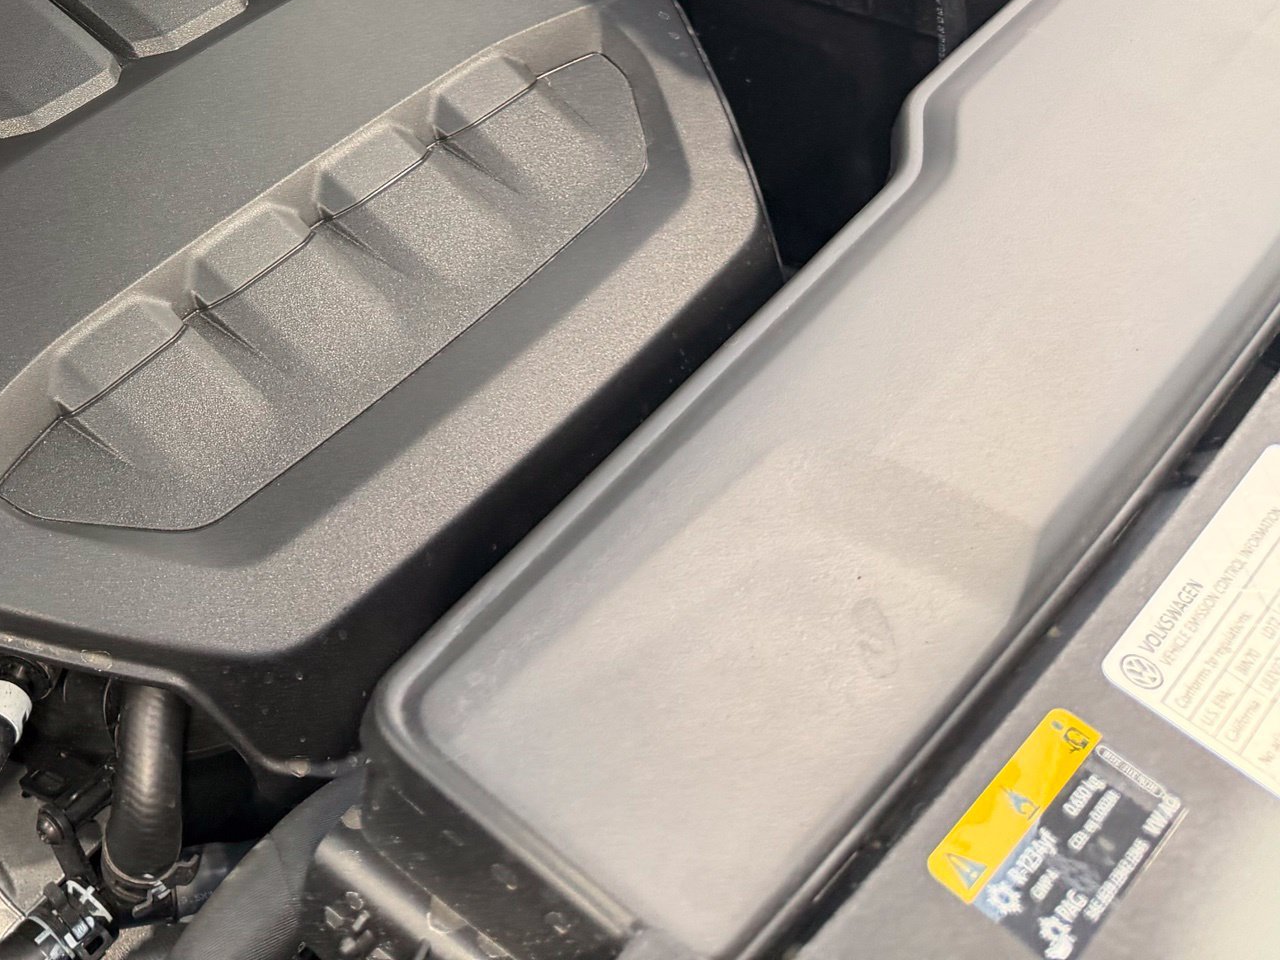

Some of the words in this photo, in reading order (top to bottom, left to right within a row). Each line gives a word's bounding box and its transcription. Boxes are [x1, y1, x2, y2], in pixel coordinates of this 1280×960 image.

[1138, 578, 1204, 653] VOLKSWAGEN
[1160, 629, 1191, 666] VEHICLE
[1184, 593, 1220, 633] EMISSION
[1213, 560, 1247, 596] CONTROL
[1054, 888, 1089, 922] PAG
